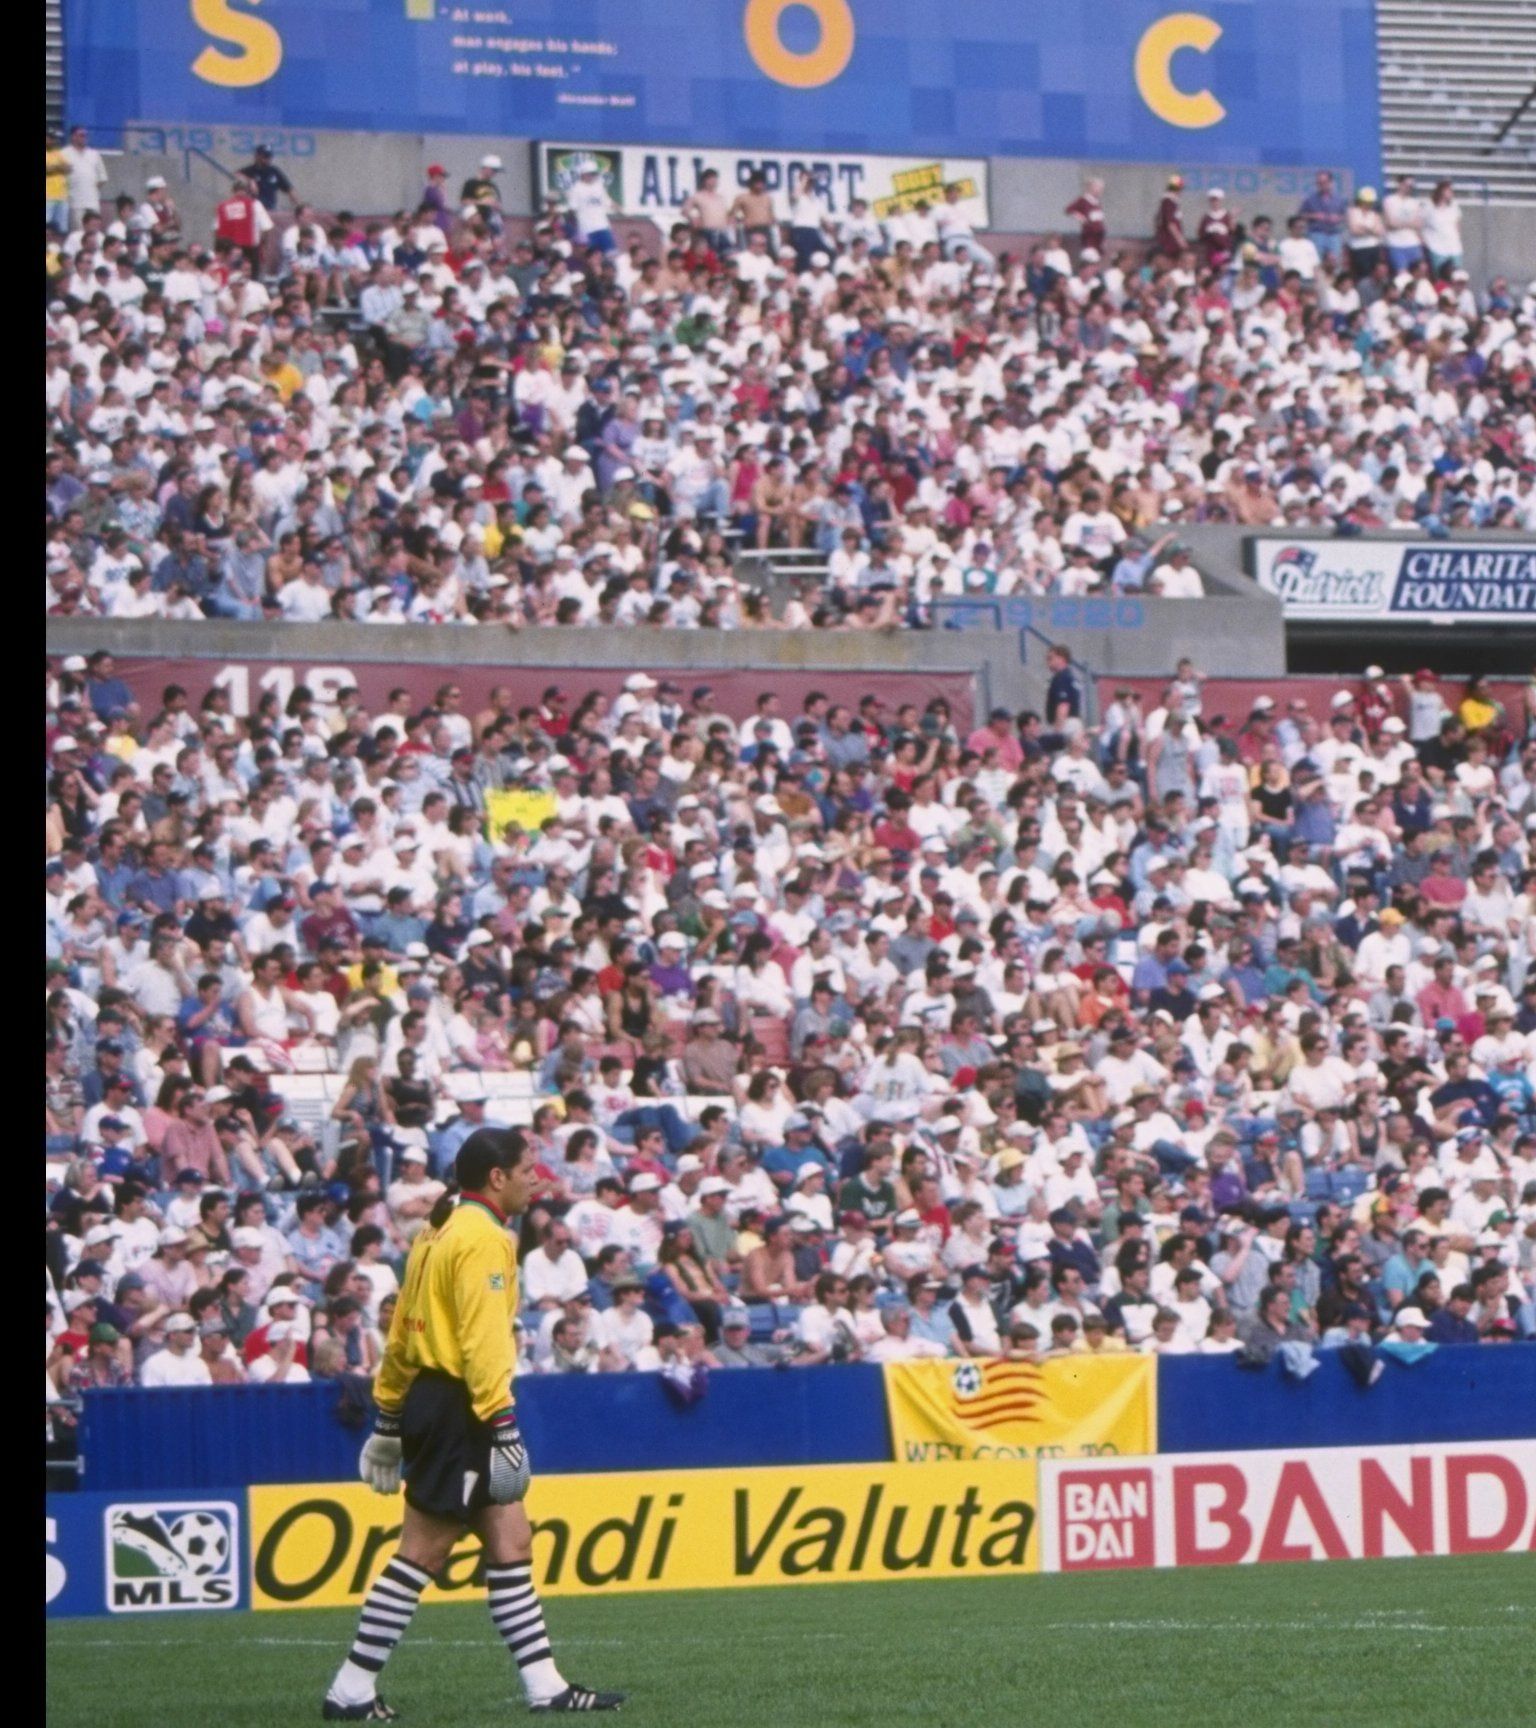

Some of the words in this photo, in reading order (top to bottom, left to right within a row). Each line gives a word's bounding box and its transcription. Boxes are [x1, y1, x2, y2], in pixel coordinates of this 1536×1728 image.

[1065, 1480, 1148, 1522] BAN
[733, 1483, 1036, 1577] Valuta
[1065, 1523, 1134, 1563] DAI
[113, 1578, 233, 1606] MLS
